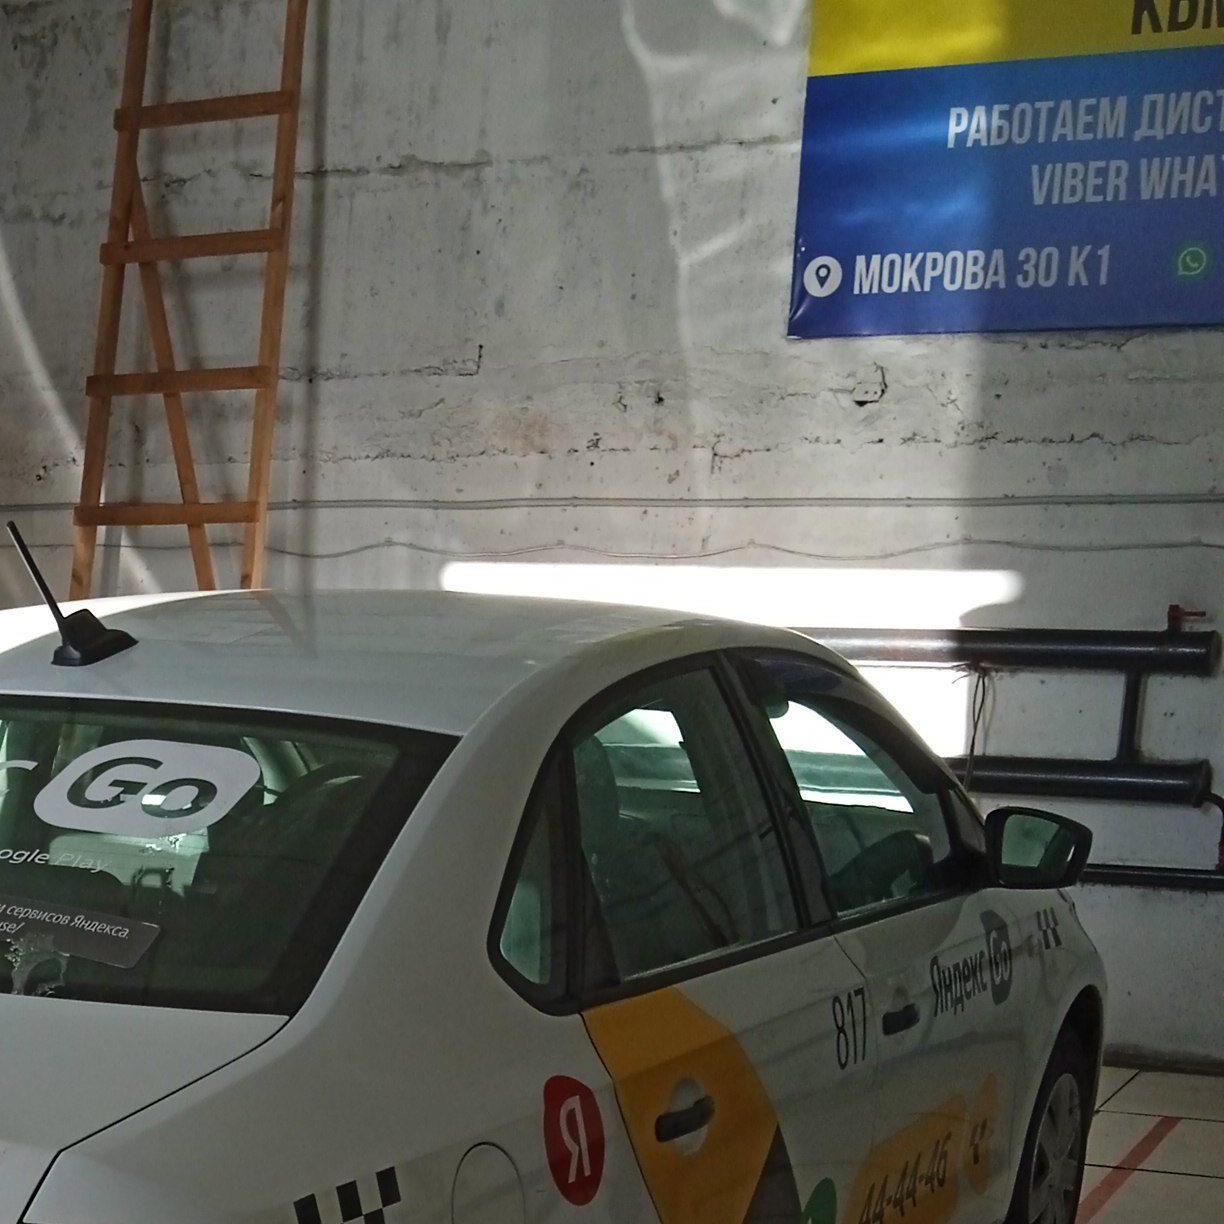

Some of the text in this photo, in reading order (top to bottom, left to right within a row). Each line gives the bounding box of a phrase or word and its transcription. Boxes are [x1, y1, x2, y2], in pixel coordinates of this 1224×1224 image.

[947, 95, 1127, 149] РАБОТАЕМ
[1031, 153, 1224, 206] VIBER WHA
[853, 248, 1007, 296] МОКРОВА
[1017, 246, 1060, 289] 30
[6, 905, 71, 927] сервисов
[929, 954, 988, 1018] Яндекс
[831, 987, 868, 1070] 817
[559, 1094, 592, 1184] Я
